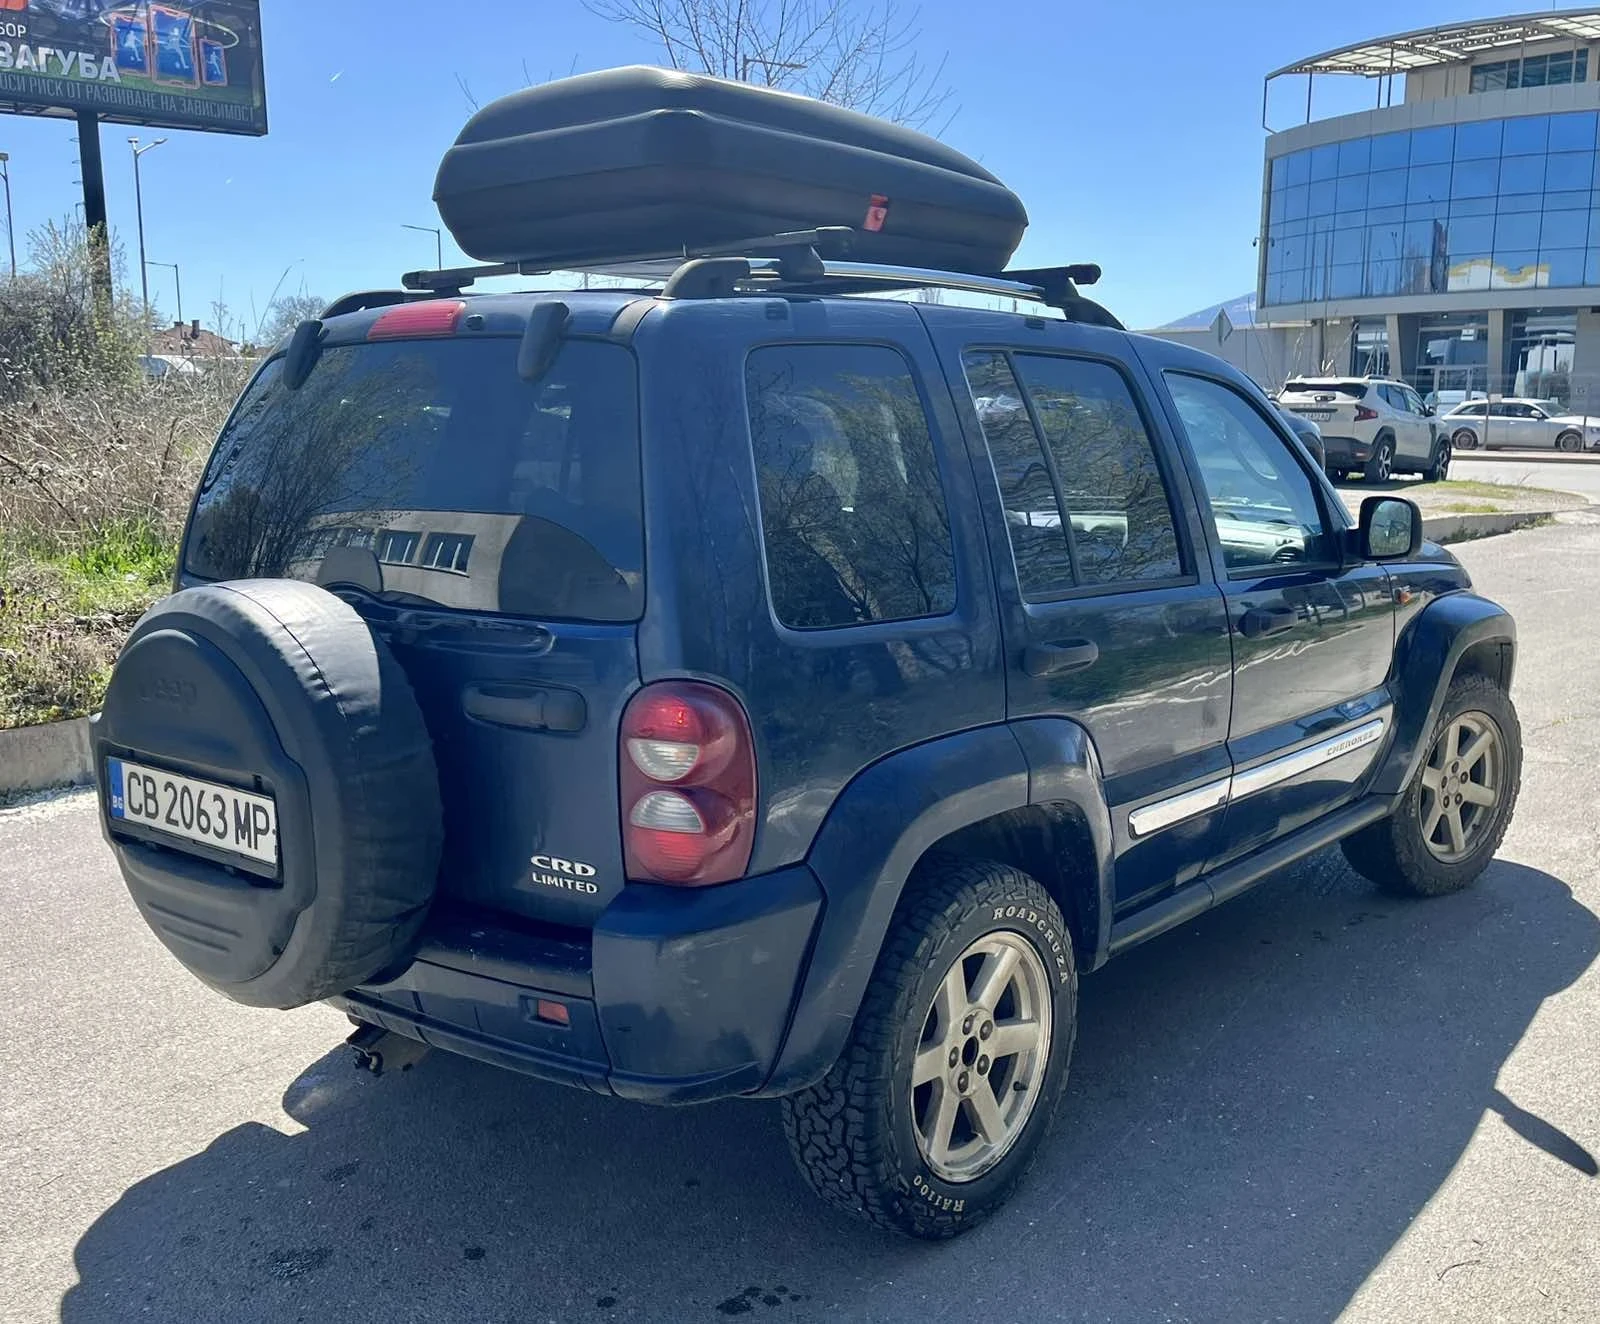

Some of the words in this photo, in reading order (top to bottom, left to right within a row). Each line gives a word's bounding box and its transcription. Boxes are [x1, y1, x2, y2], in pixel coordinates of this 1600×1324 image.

[0, 41, 121, 83] ЗАГУБА
[30, 77, 63, 97] РИСК
[67, 81, 80, 99] ОТ
[86, 84, 156, 109] РАЗВИВАНЕ
[160, 95, 177, 112] НА
[182, 98, 254, 121] ЗАВИСИМОСТ
[112, 795, 123, 809] BG
[127, 771, 159, 820] CB
[164, 781, 228, 840] 2063
[233, 798, 270, 850] MP
[530, 855, 597, 877] CRD
[532, 872, 598, 894] LIMITED
[992, 905, 1069, 984] ROADCRUZA
